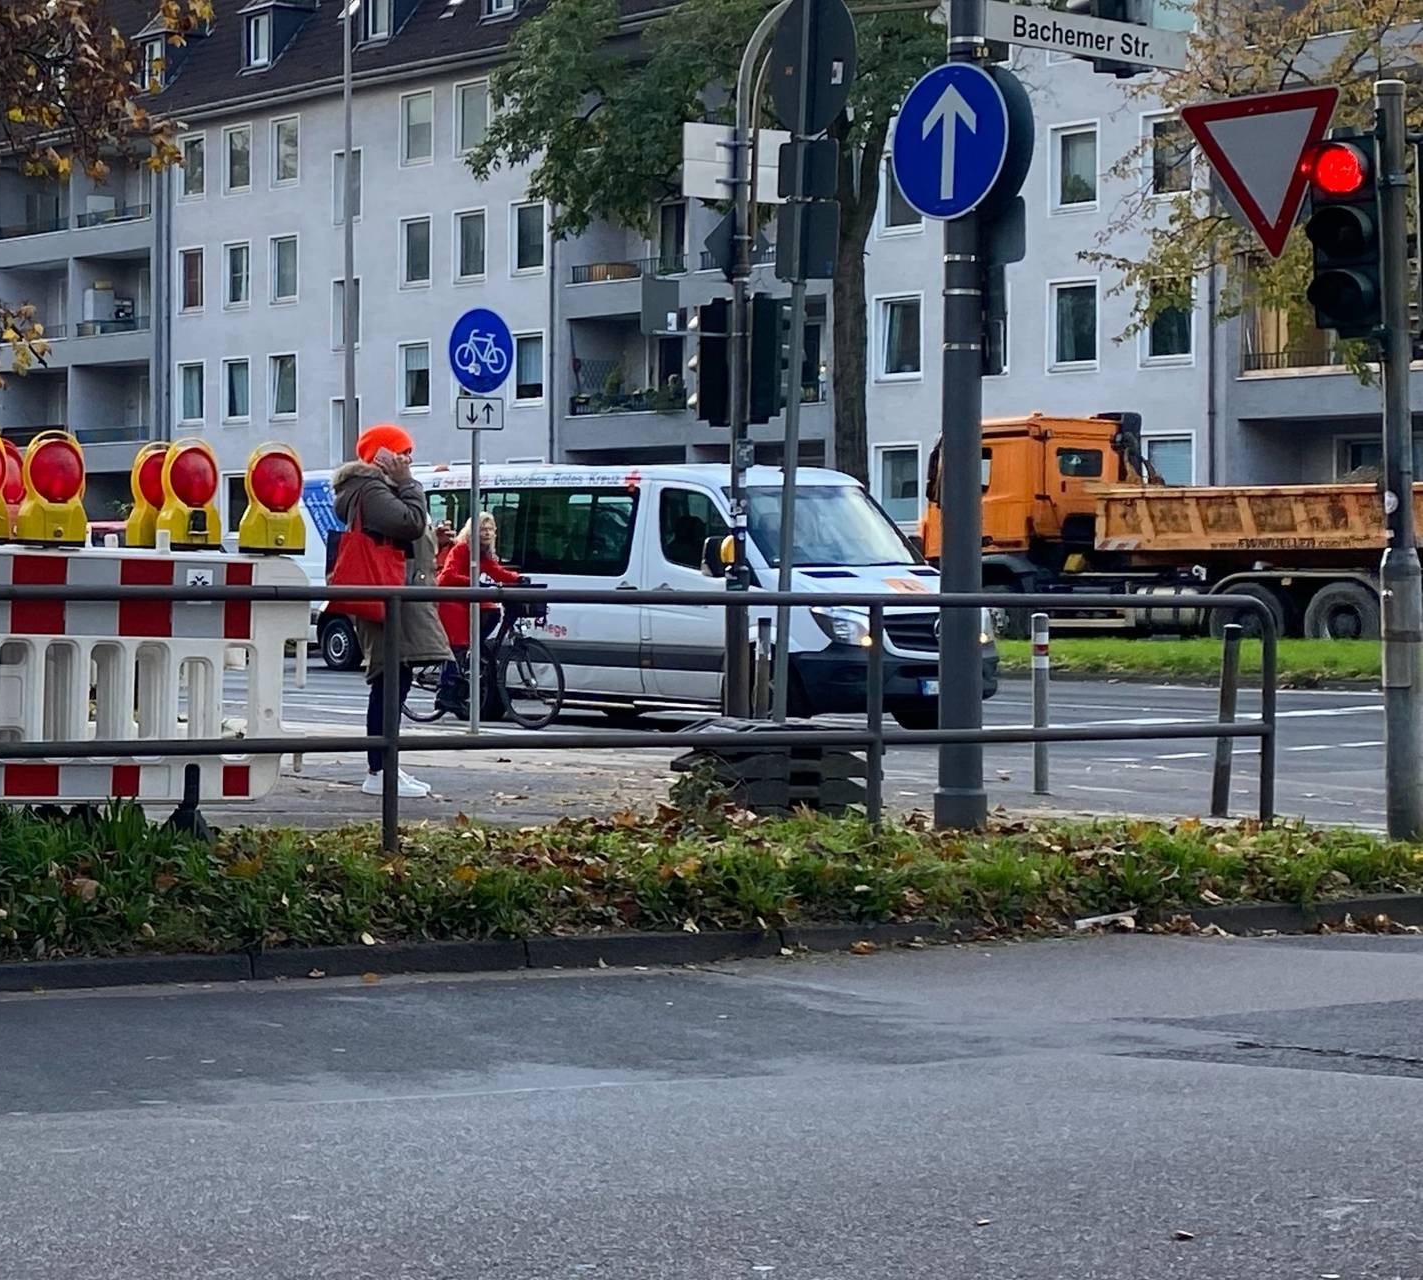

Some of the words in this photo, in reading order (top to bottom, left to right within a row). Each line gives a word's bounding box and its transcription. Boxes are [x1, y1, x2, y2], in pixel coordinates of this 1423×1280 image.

[1013, 15, 1114, 51] Bachemer
[1120, 33, 1154, 59] Str.
[494, 474, 547, 486] Deutsches
[553, 473, 583, 485] Rotes
[589, 473, 620, 485] Kreuz
